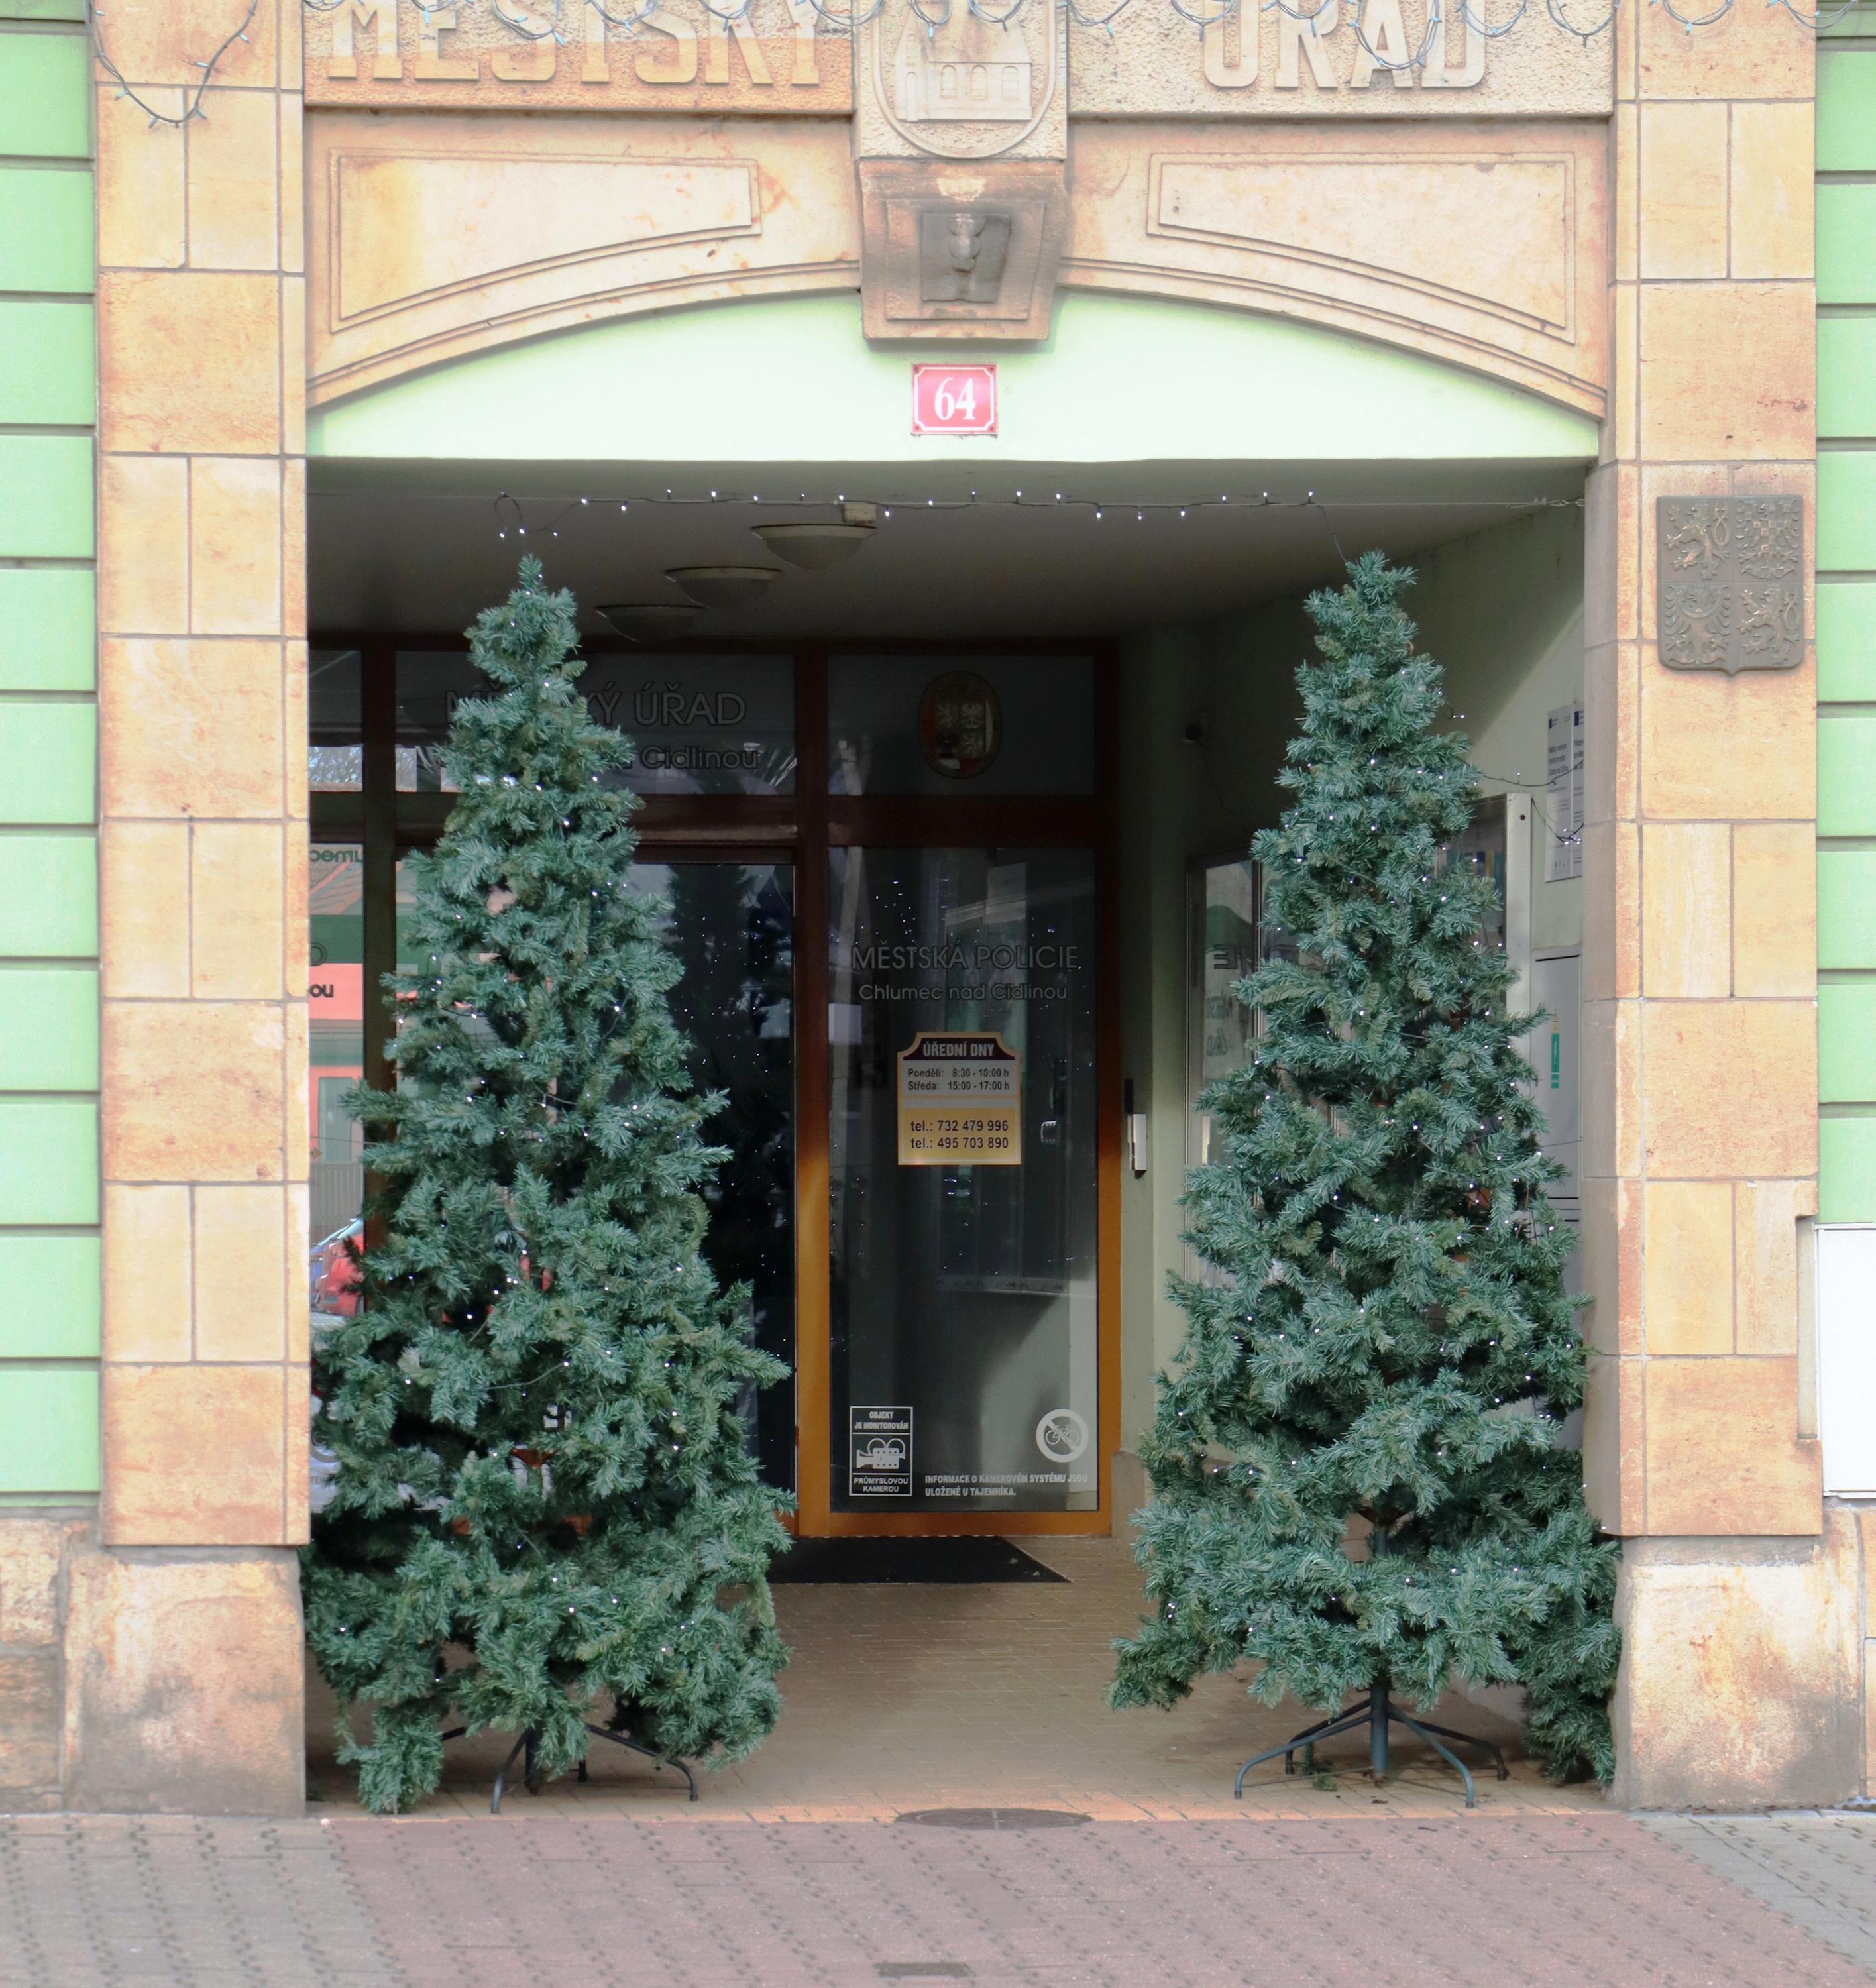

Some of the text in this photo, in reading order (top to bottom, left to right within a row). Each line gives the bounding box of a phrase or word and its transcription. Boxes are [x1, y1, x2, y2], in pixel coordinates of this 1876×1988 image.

[934, 376, 976, 421] 64
[634, 681, 746, 727] ÚŘAD
[641, 746, 759, 770] Cidlinou
[851, 939, 1078, 970] MĚSTSKÁ POLICIE
[859, 983, 1068, 1001] Chlumec nad Cidlinou
[922, 1041, 995, 1057] ÚŘEDNÍ DNY
[908, 1068, 944, 1078] Pondělí:
[952, 1068, 971, 1078] 8:30
[979, 1068, 1002, 1078] 10:00
[1003, 1068, 1010, 1078] h
[908, 1081, 940, 1091] Středa:
[948, 1081, 971, 1091] 15:00
[979, 1081, 1003, 1091] 17:00
[1004, 1081, 1010, 1091] h
[910, 1120, 1009, 1132] tel.: 732 479 996
[910, 1137, 1009, 1149] tel.: 495 703 890
[869, 1411, 895, 1419] OBJEKT
[854, 1420, 909, 1430] JE MONITOROVÁN
[854, 1476, 909, 1485] PRŮMYSLOVOU
[925, 1472, 1089, 1484] INFORMACE O KAMEROVÉM SYSTÉMU JSOU
[925, 1486, 1017, 1497] ULOŽENÉ U TAJEMNÍKA.
